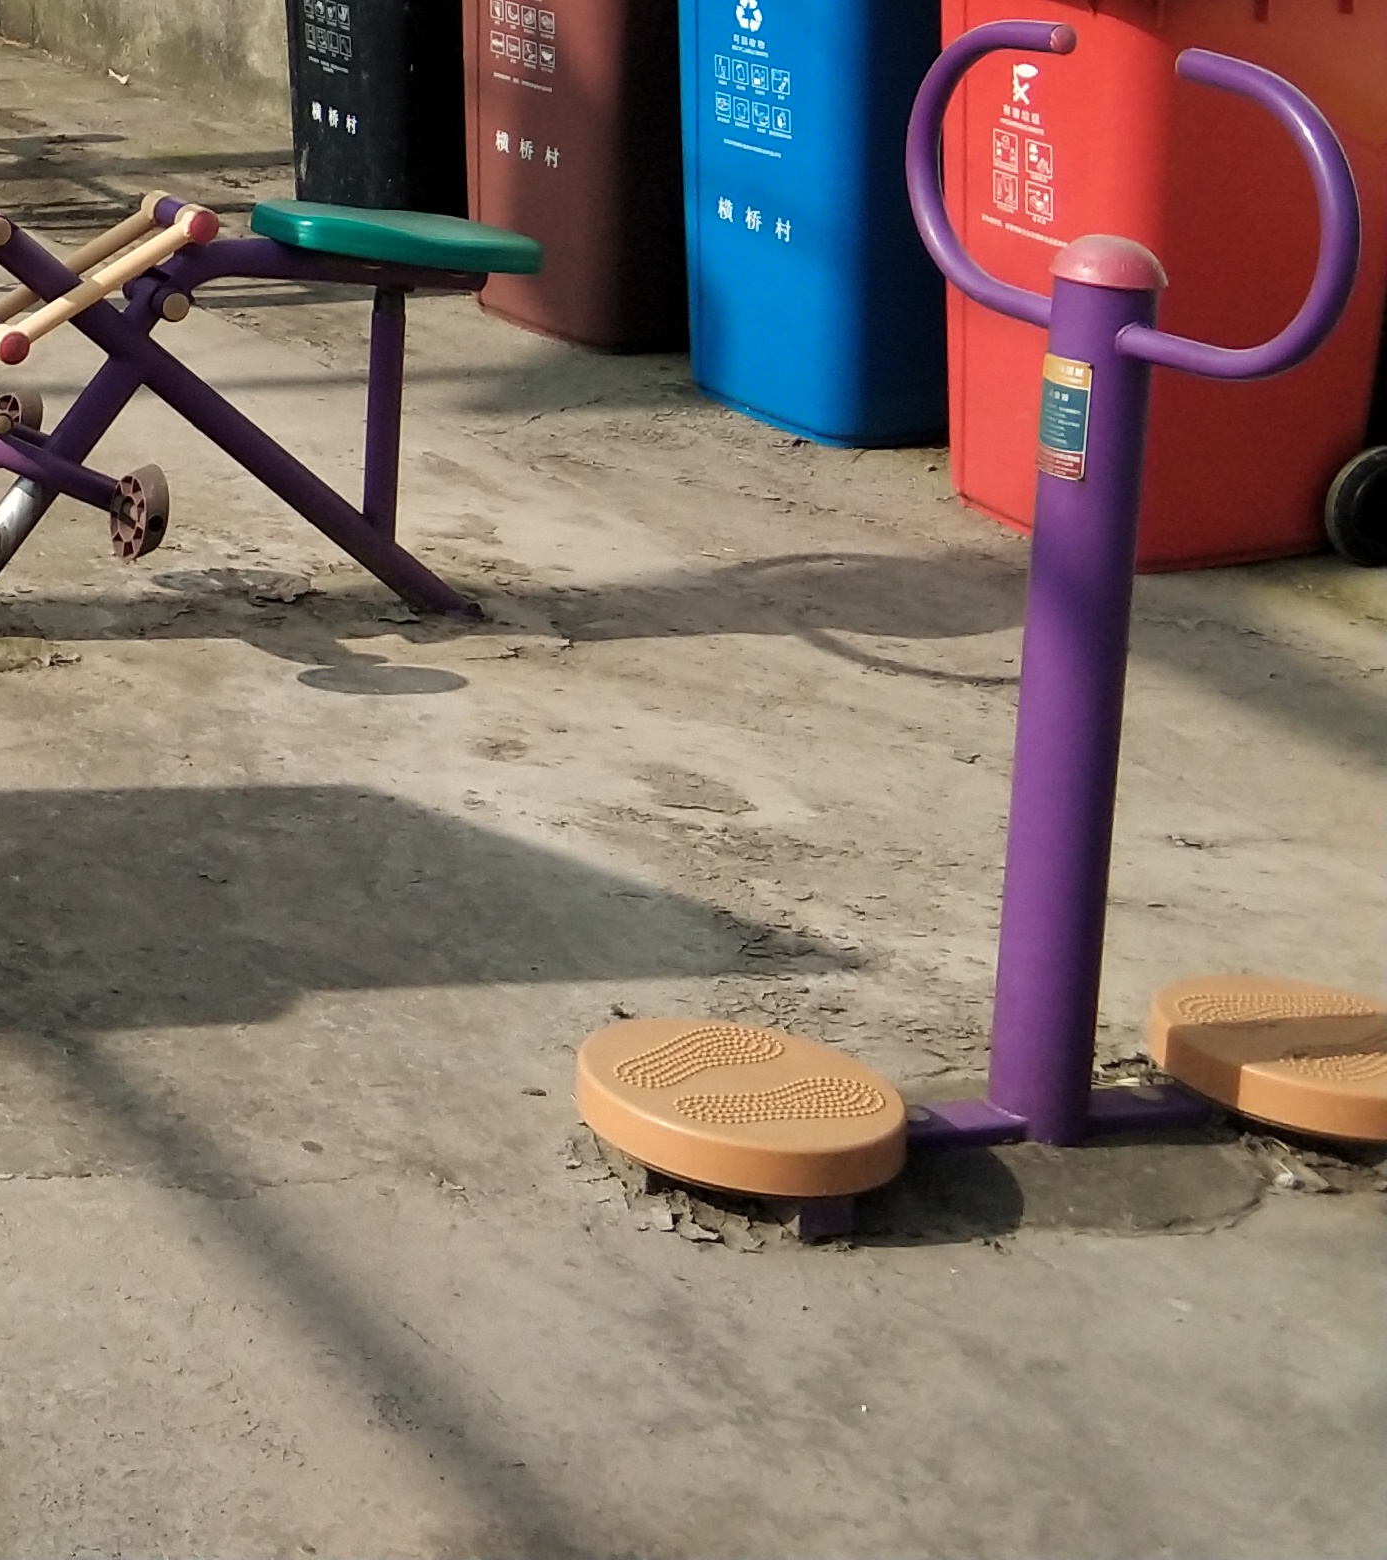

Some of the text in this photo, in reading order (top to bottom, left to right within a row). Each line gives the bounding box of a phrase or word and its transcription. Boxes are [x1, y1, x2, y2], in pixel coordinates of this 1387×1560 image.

[311, 101, 358, 135] 横桥村
[495, 129, 560, 168] 横桥村
[717, 195, 791, 242] 横桥村
